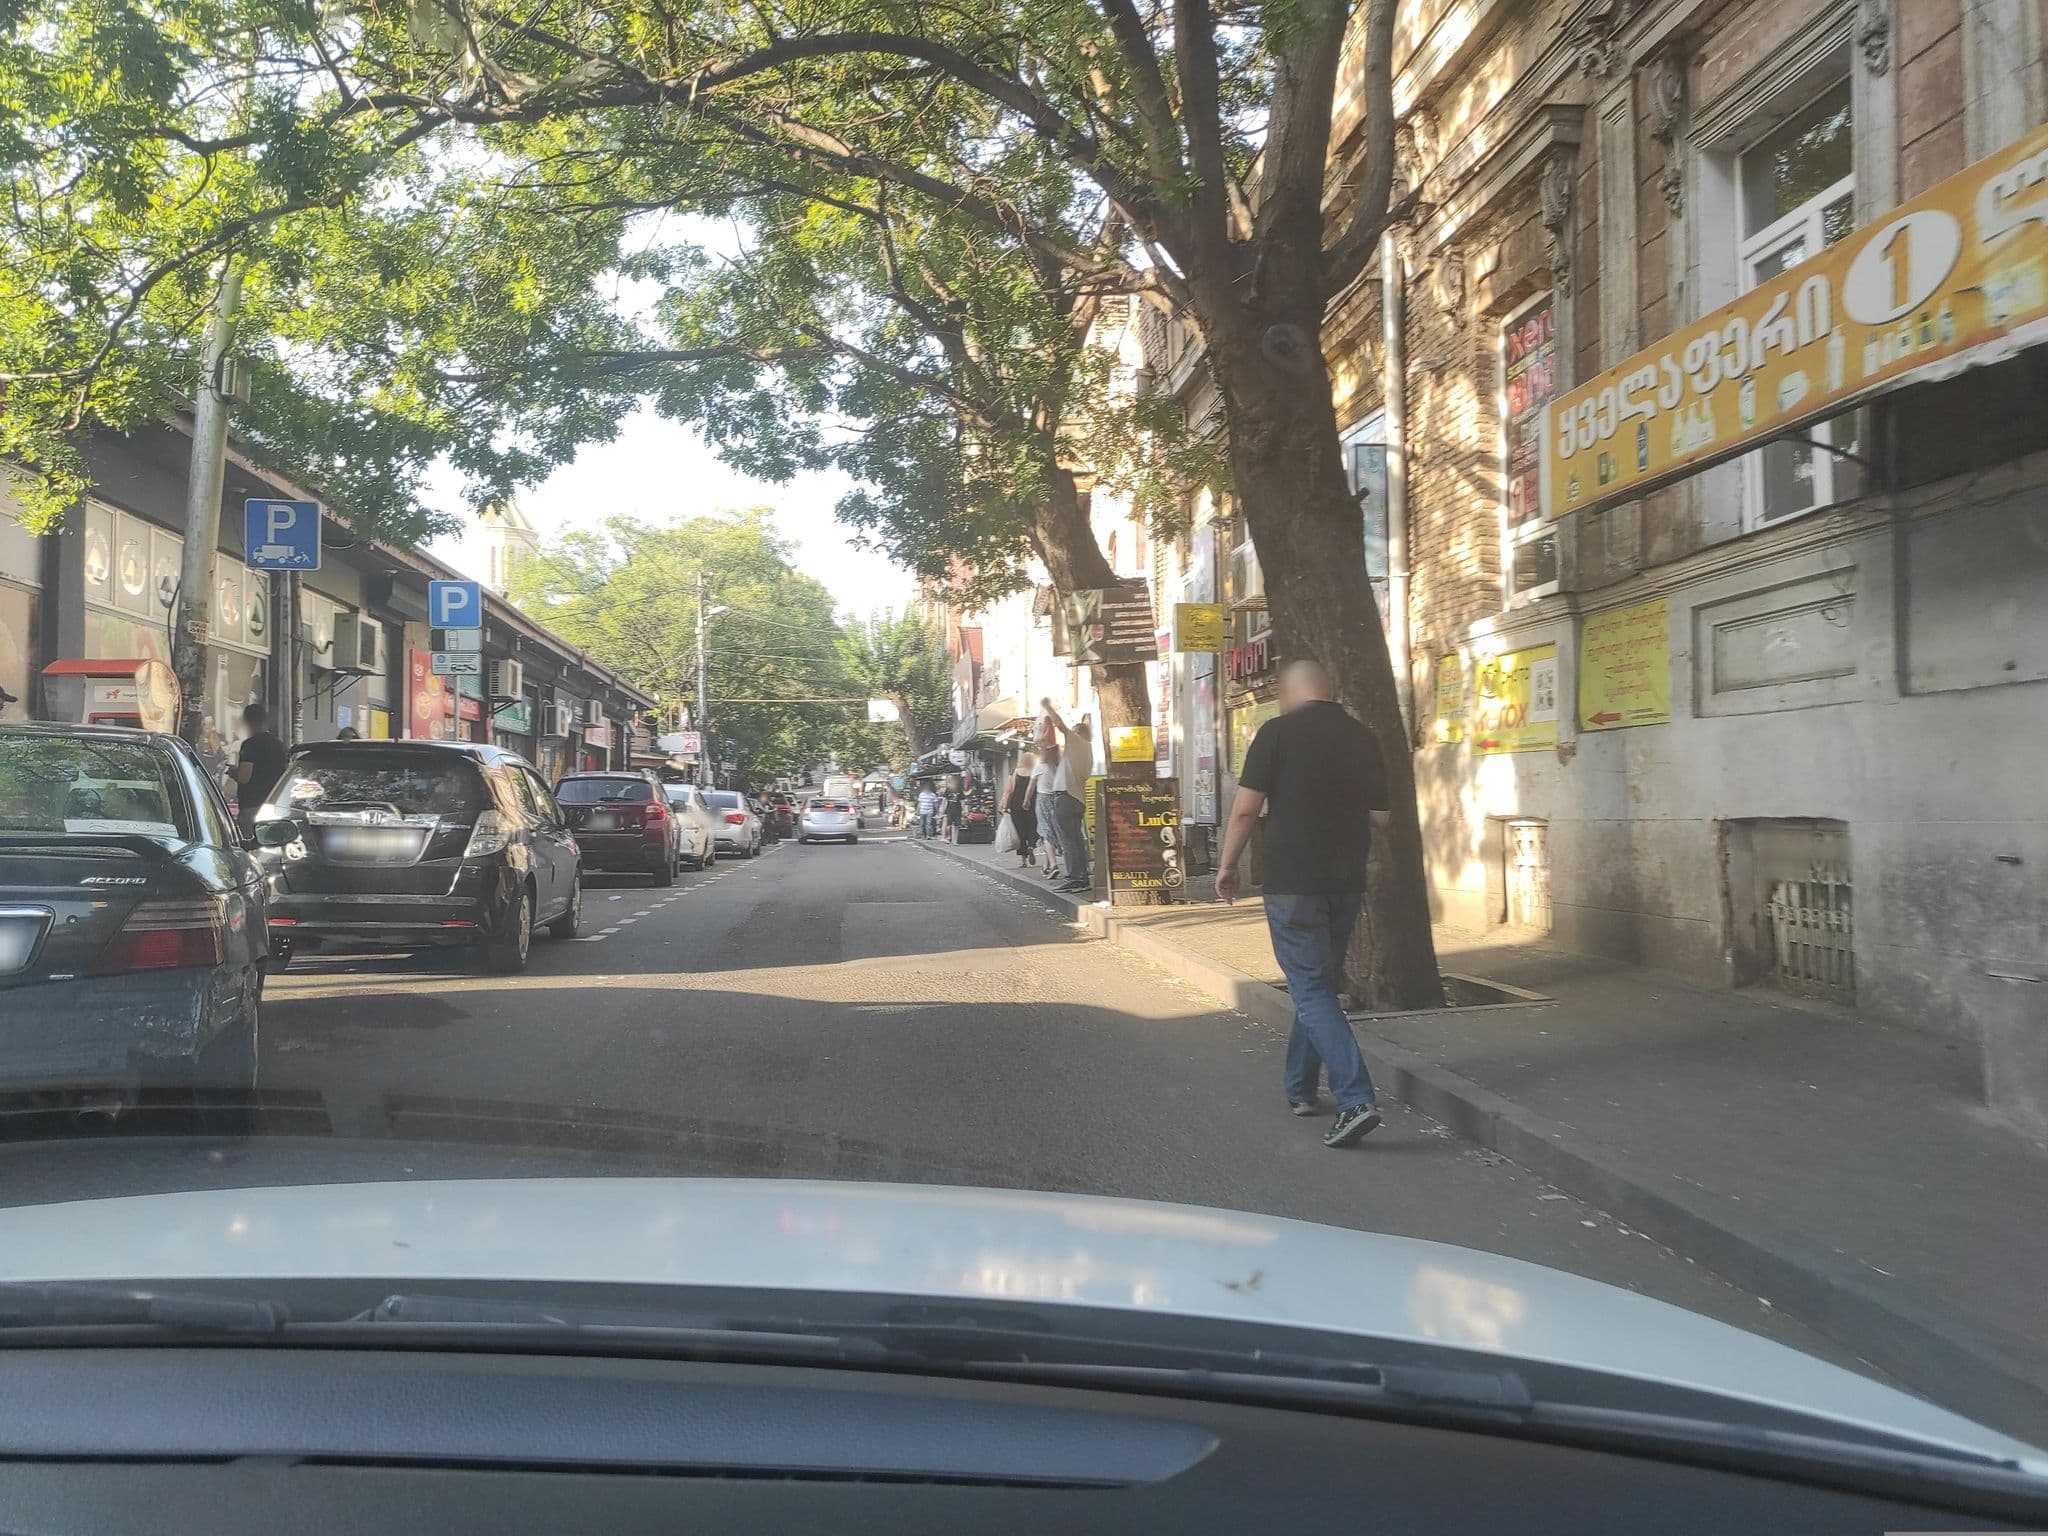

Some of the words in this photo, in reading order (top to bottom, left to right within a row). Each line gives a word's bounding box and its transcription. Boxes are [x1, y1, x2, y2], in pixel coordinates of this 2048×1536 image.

[1558, 274, 1831, 460] ყველაფერი
[1881, 223, 1911, 311] 1
[267, 504, 297, 543] P
[440, 586, 468, 622] P
[1112, 871, 1149, 880] BEAUTY
[1131, 879, 1163, 888] SALON
